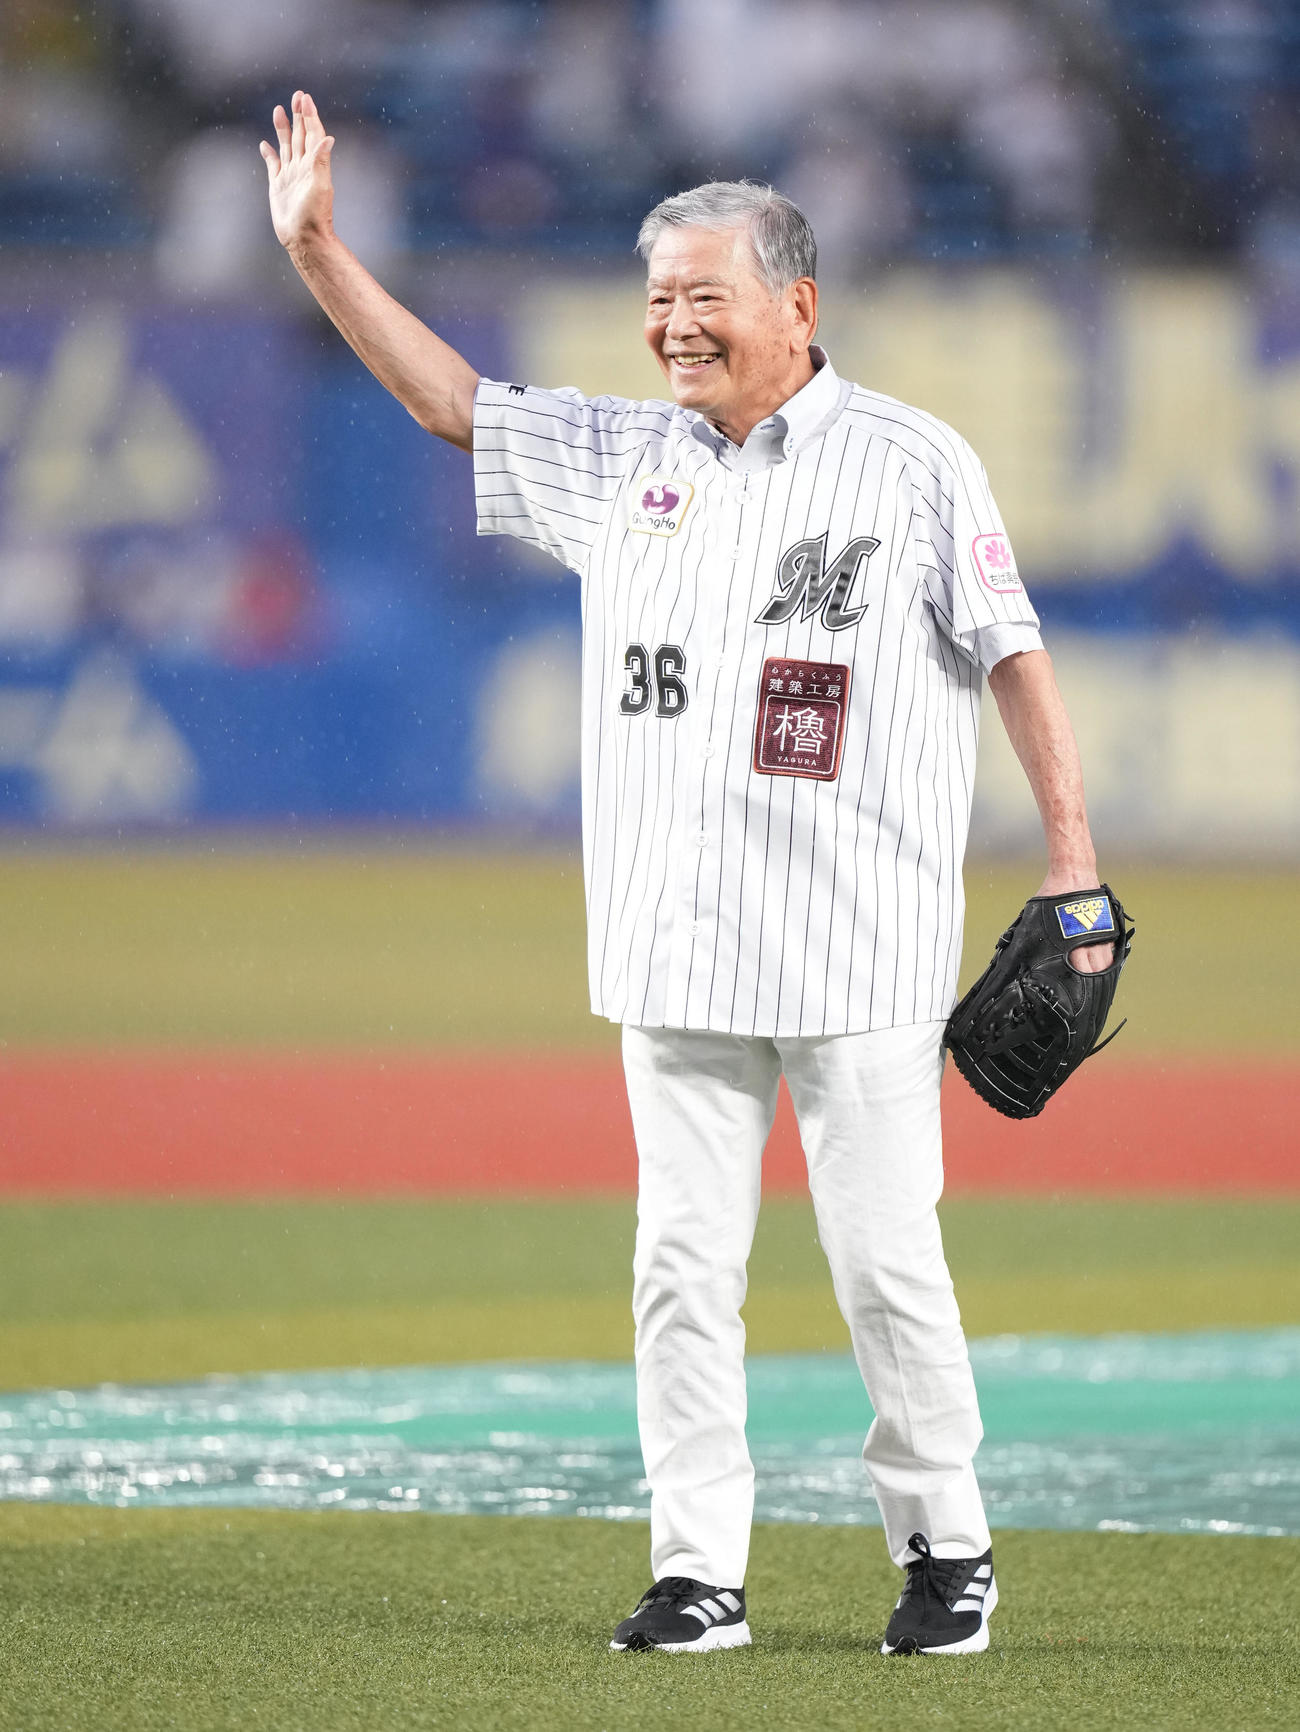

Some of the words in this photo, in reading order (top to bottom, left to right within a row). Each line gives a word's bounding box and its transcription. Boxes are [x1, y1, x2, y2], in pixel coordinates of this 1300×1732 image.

[754, 530, 881, 632] M
[618, 642, 689, 719] 36
[768, 678, 842, 698] 建築工房
[772, 704, 828, 755] 櫓
[777, 755, 817, 767] YAGURA
[1064, 899, 1104, 915] adidas
